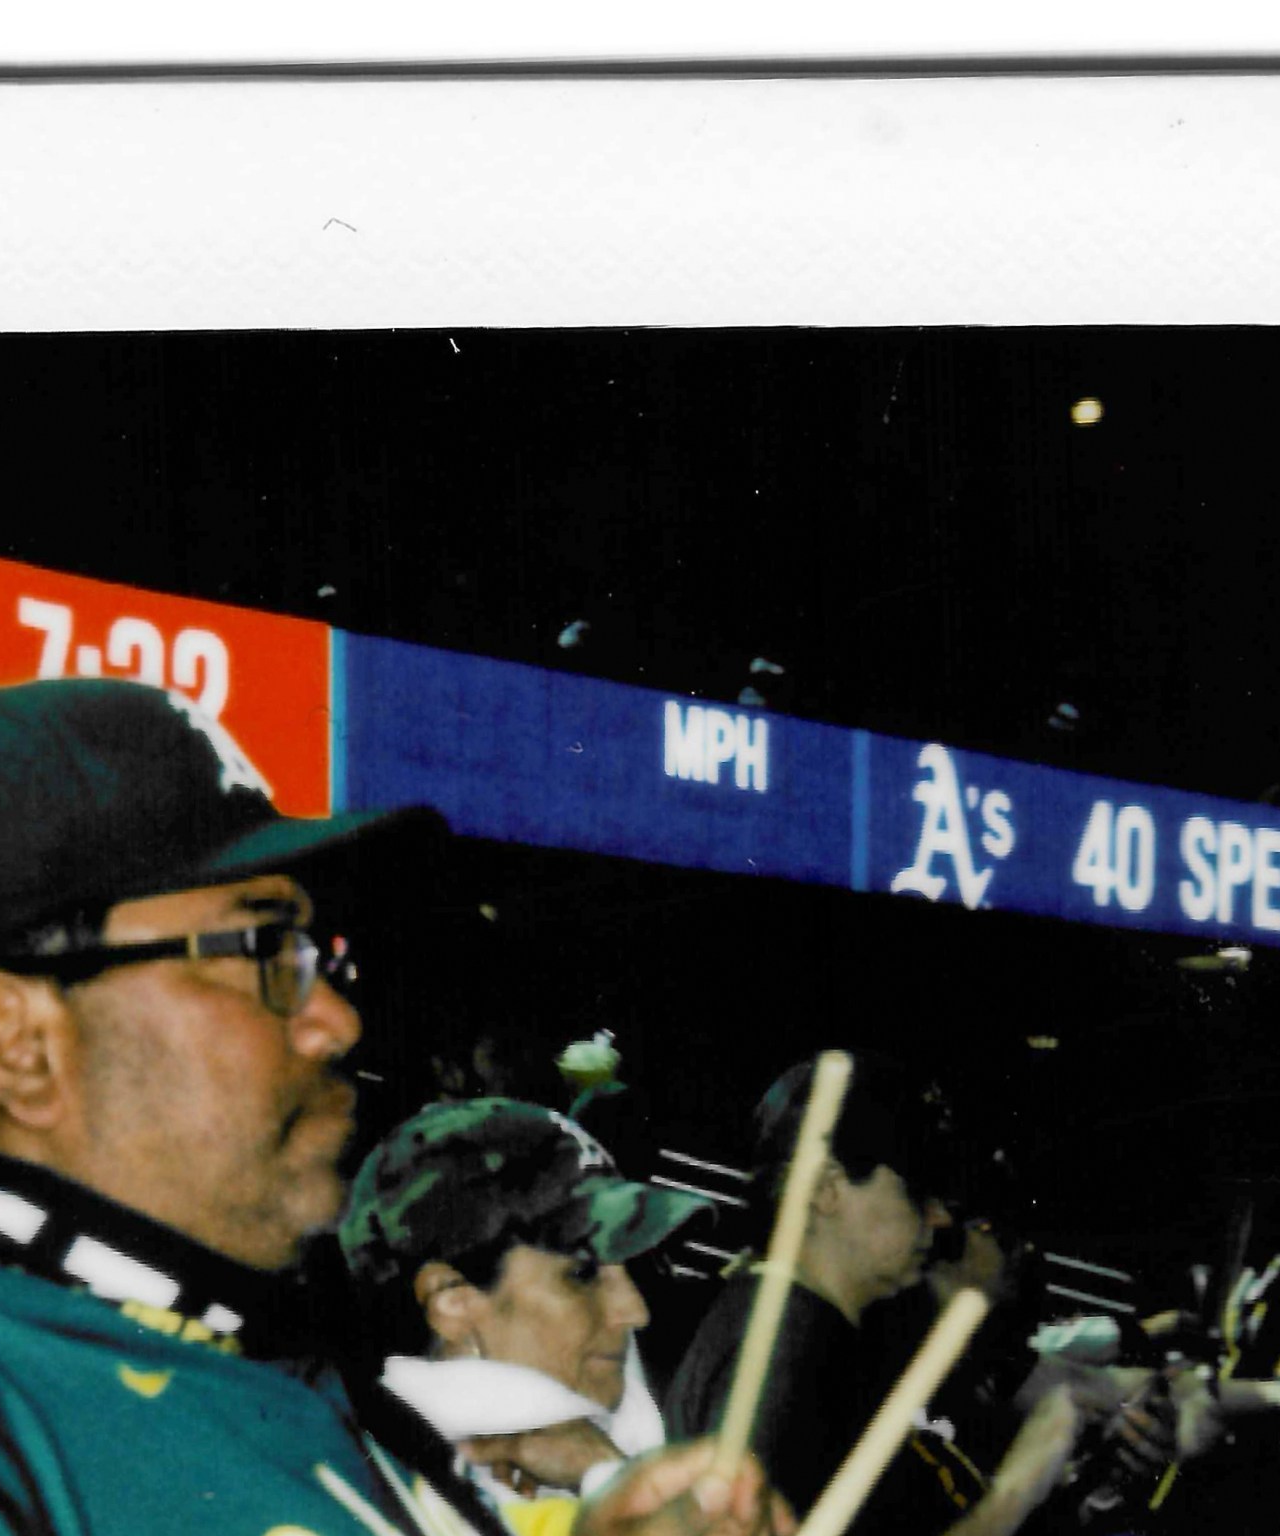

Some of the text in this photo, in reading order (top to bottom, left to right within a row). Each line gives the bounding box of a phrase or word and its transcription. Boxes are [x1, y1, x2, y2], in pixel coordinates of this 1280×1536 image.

[663, 699, 768, 793] MPH
[890, 742, 1015, 911] A's
[1073, 799, 1156, 912] 40
